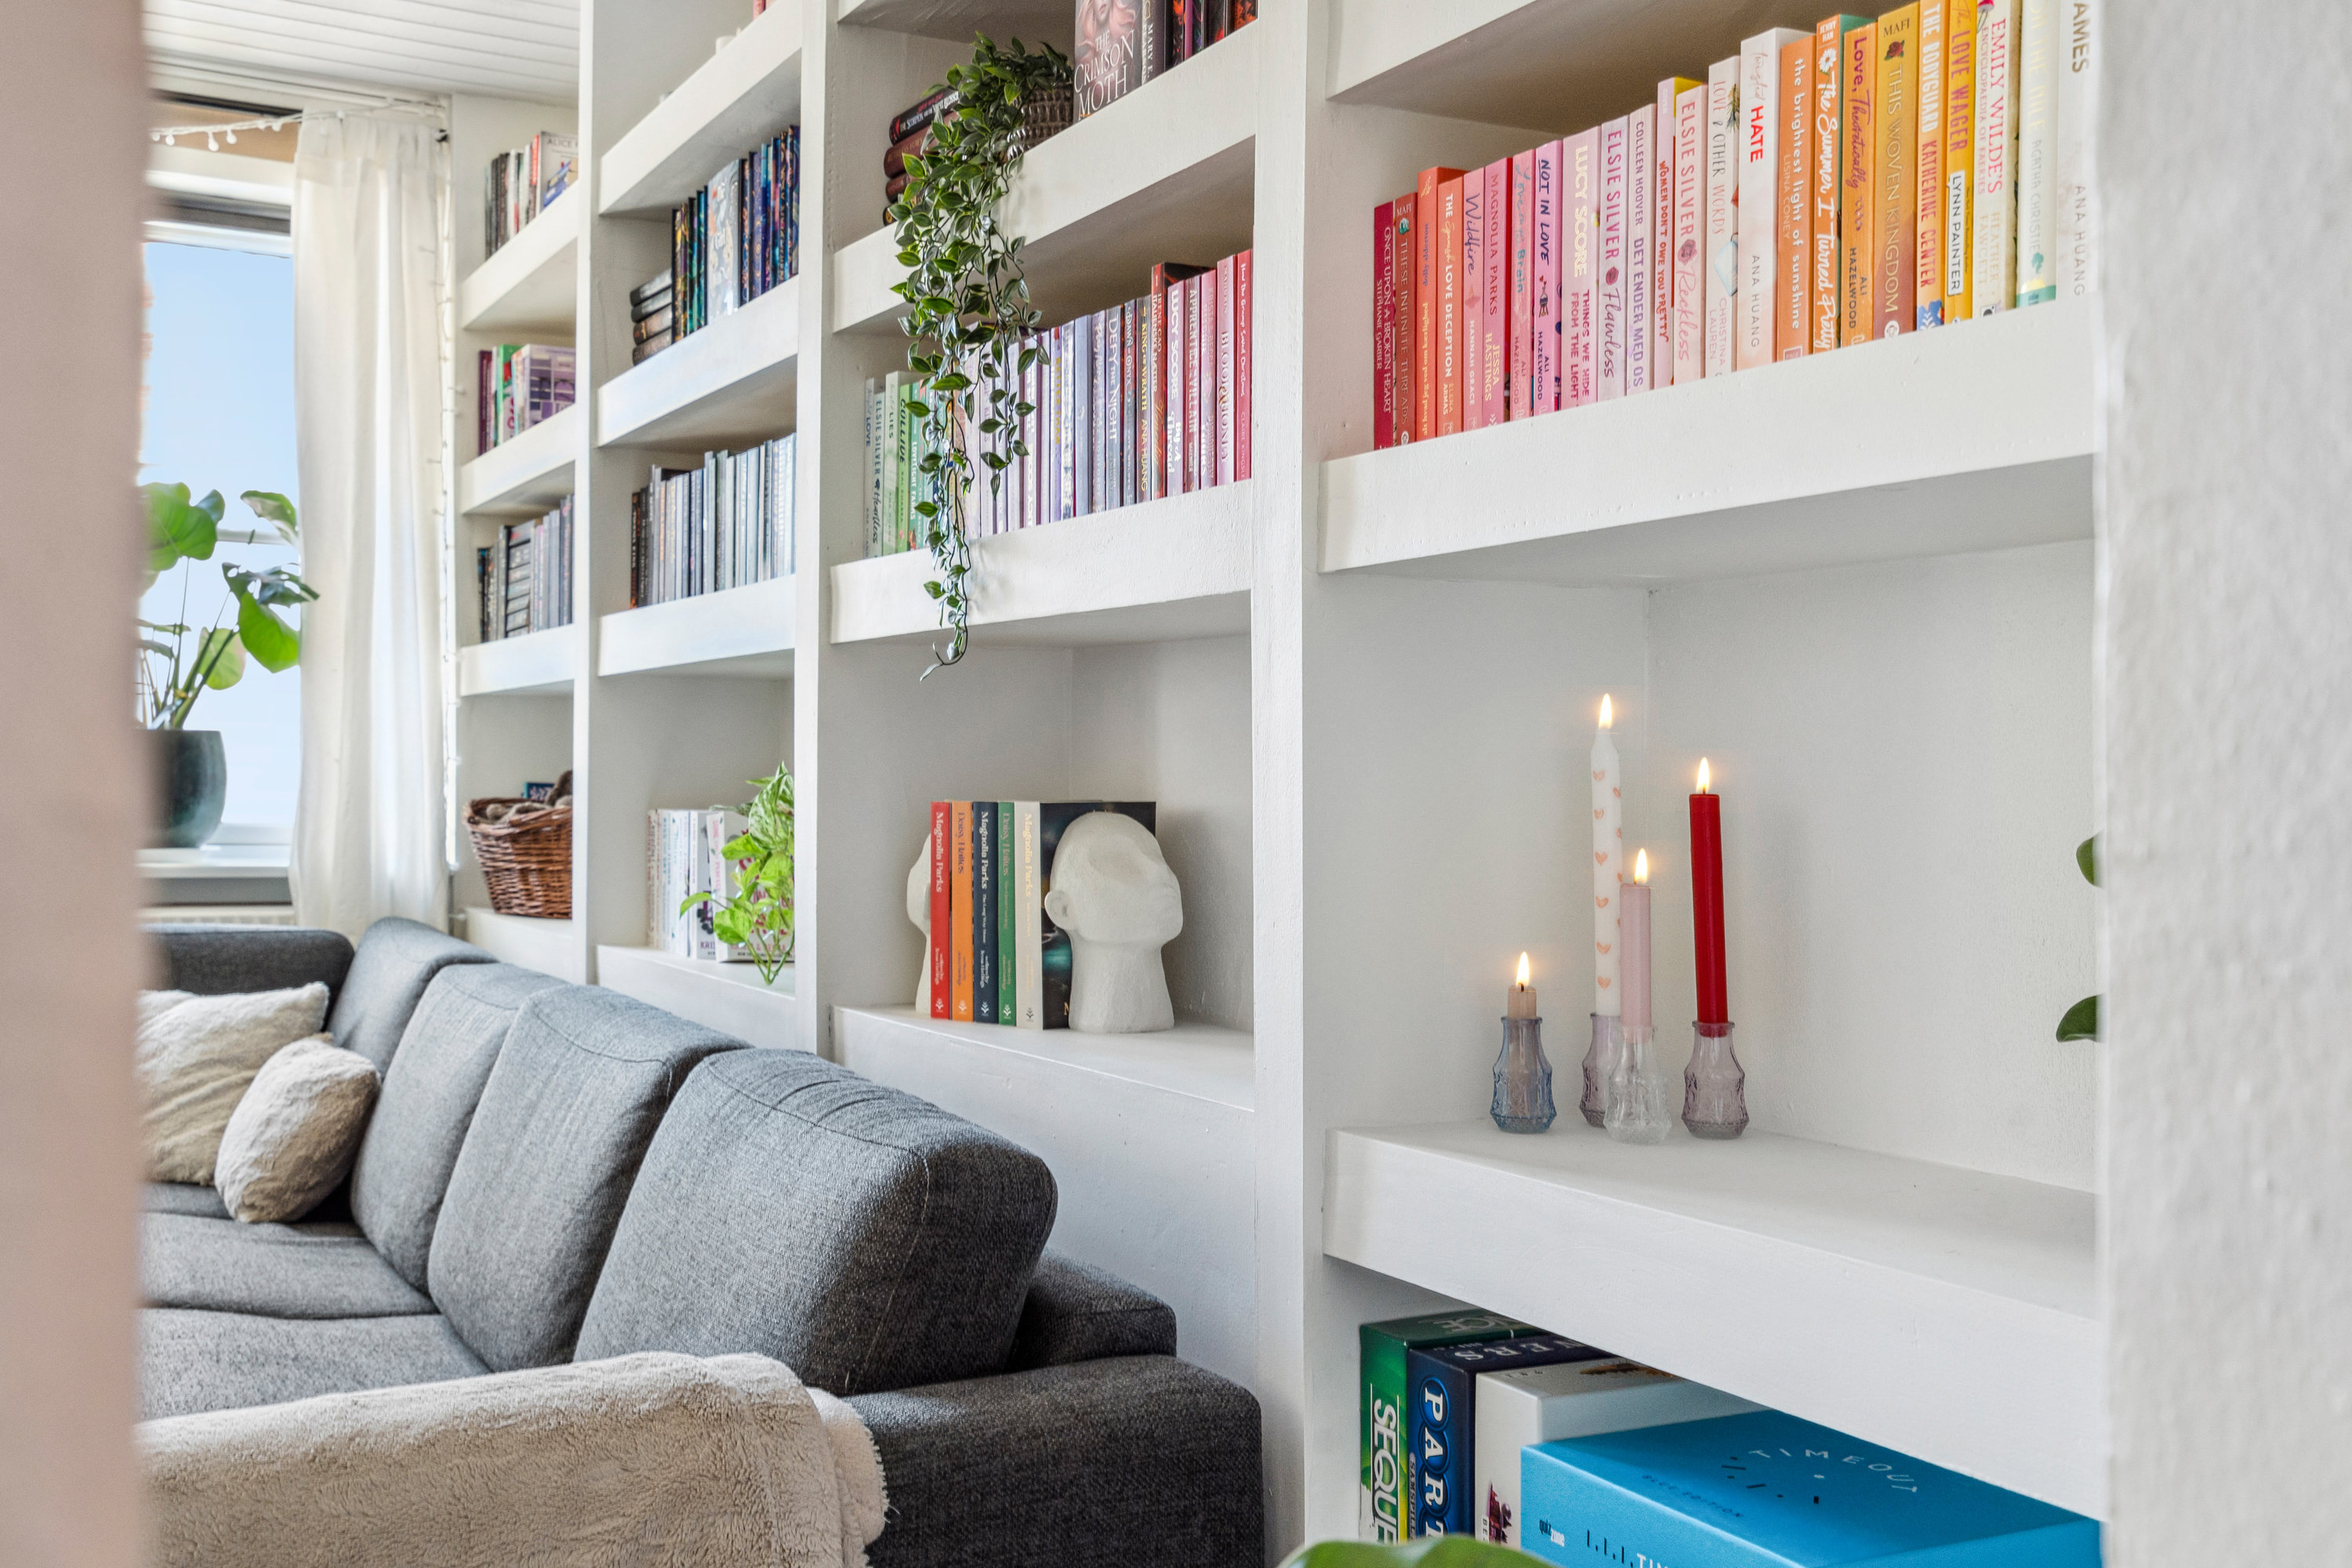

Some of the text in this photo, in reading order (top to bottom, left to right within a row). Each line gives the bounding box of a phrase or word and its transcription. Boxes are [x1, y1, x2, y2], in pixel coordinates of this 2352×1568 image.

[1074, 30, 1134, 93] CRIMSON
[1095, 30, 1110, 53] THE
[1820, 20, 1836, 34] JENNY
[1822, 32, 1834, 43] HAN
[1882, 18, 1911, 38] MAFI
[2072, 0, 2090, 74] AMES
[1079, 65, 1127, 121] MOTH
[1147, 65, 1153, 78] E.
[1922, 2, 1940, 134] THE BODYGUARD
[1950, 30, 1970, 153] LOVE WAGER
[1980, 26, 1989, 123] ENCYCLOPAEDIA
[1988, 18, 2006, 194] EMILY WILDE'S
[1750, 105, 1764, 163] HATE
[1846, 37, 1871, 189] Love, Theoretically
[1605, 130, 1621, 260] ELSIE SILVER
[1635, 121, 1644, 226] COLLEEN HOOVER
[1658, 160, 1669, 203] WOMEN
[1680, 101, 1695, 237] ELSIE SILVER
[1712, 81, 1726, 235] LOVE OTHER WORDS
[1791, 58, 1806, 330] the brightest light of sunshine
[1885, 64, 1903, 314] THIS WOVEN KINGDOM
[2029, 140, 2042, 252] AGATHA CHRISTIE
[1396, 203, 1411, 216] MAFI
[1465, 193, 1481, 275] Wildfire
[1490, 174, 1499, 259] MAGNOLIA
[1540, 159, 1551, 266] NOT IN LOVE
[1574, 144, 1588, 278] LUCY SCORE
[1813, 71, 1838, 353] The Summer Turned Pretty
[1920, 140, 1937, 289] KATHERINE CENTER
[1951, 175, 1962, 291] LYNN PAINTER
[1991, 211, 1999, 283] HEATHER
[2074, 186, 2086, 296] ANA HUANG
[1658, 241, 1667, 267] OWE
[1849, 247, 1857, 329] HAZELWOOD
[1108, 314, 1119, 366] DEFY
[1189, 289, 1198, 369] APPRENTICE
[1602, 288, 1621, 378] Flawless
[1633, 237, 1644, 387] DET ENDER MED OS
[1656, 292, 1668, 343] PRETTY
[1676, 263, 1698, 361] Reckless
[1751, 255, 1760, 349] ANA HUANG
[1570, 292, 1579, 401] FROM THE LIGHT
[1582, 342, 1589, 363] WE
[1108, 384, 1120, 444] NIGHT
[1174, 422, 1181, 444] By
[1189, 376, 1198, 433] VILLAIN
[934, 811, 943, 860] Magnolia
[956, 812, 965, 839] Daisy
[979, 811, 989, 858] Magnolia
[1000, 813, 1010, 840] Daisy
[1022, 813, 1033, 863] Magnolia
[1748, 1448, 1918, 1493] TIMEOUT
[1539, 1519, 1552, 1535] quiz
[1550, 1533, 1565, 1548] zone
